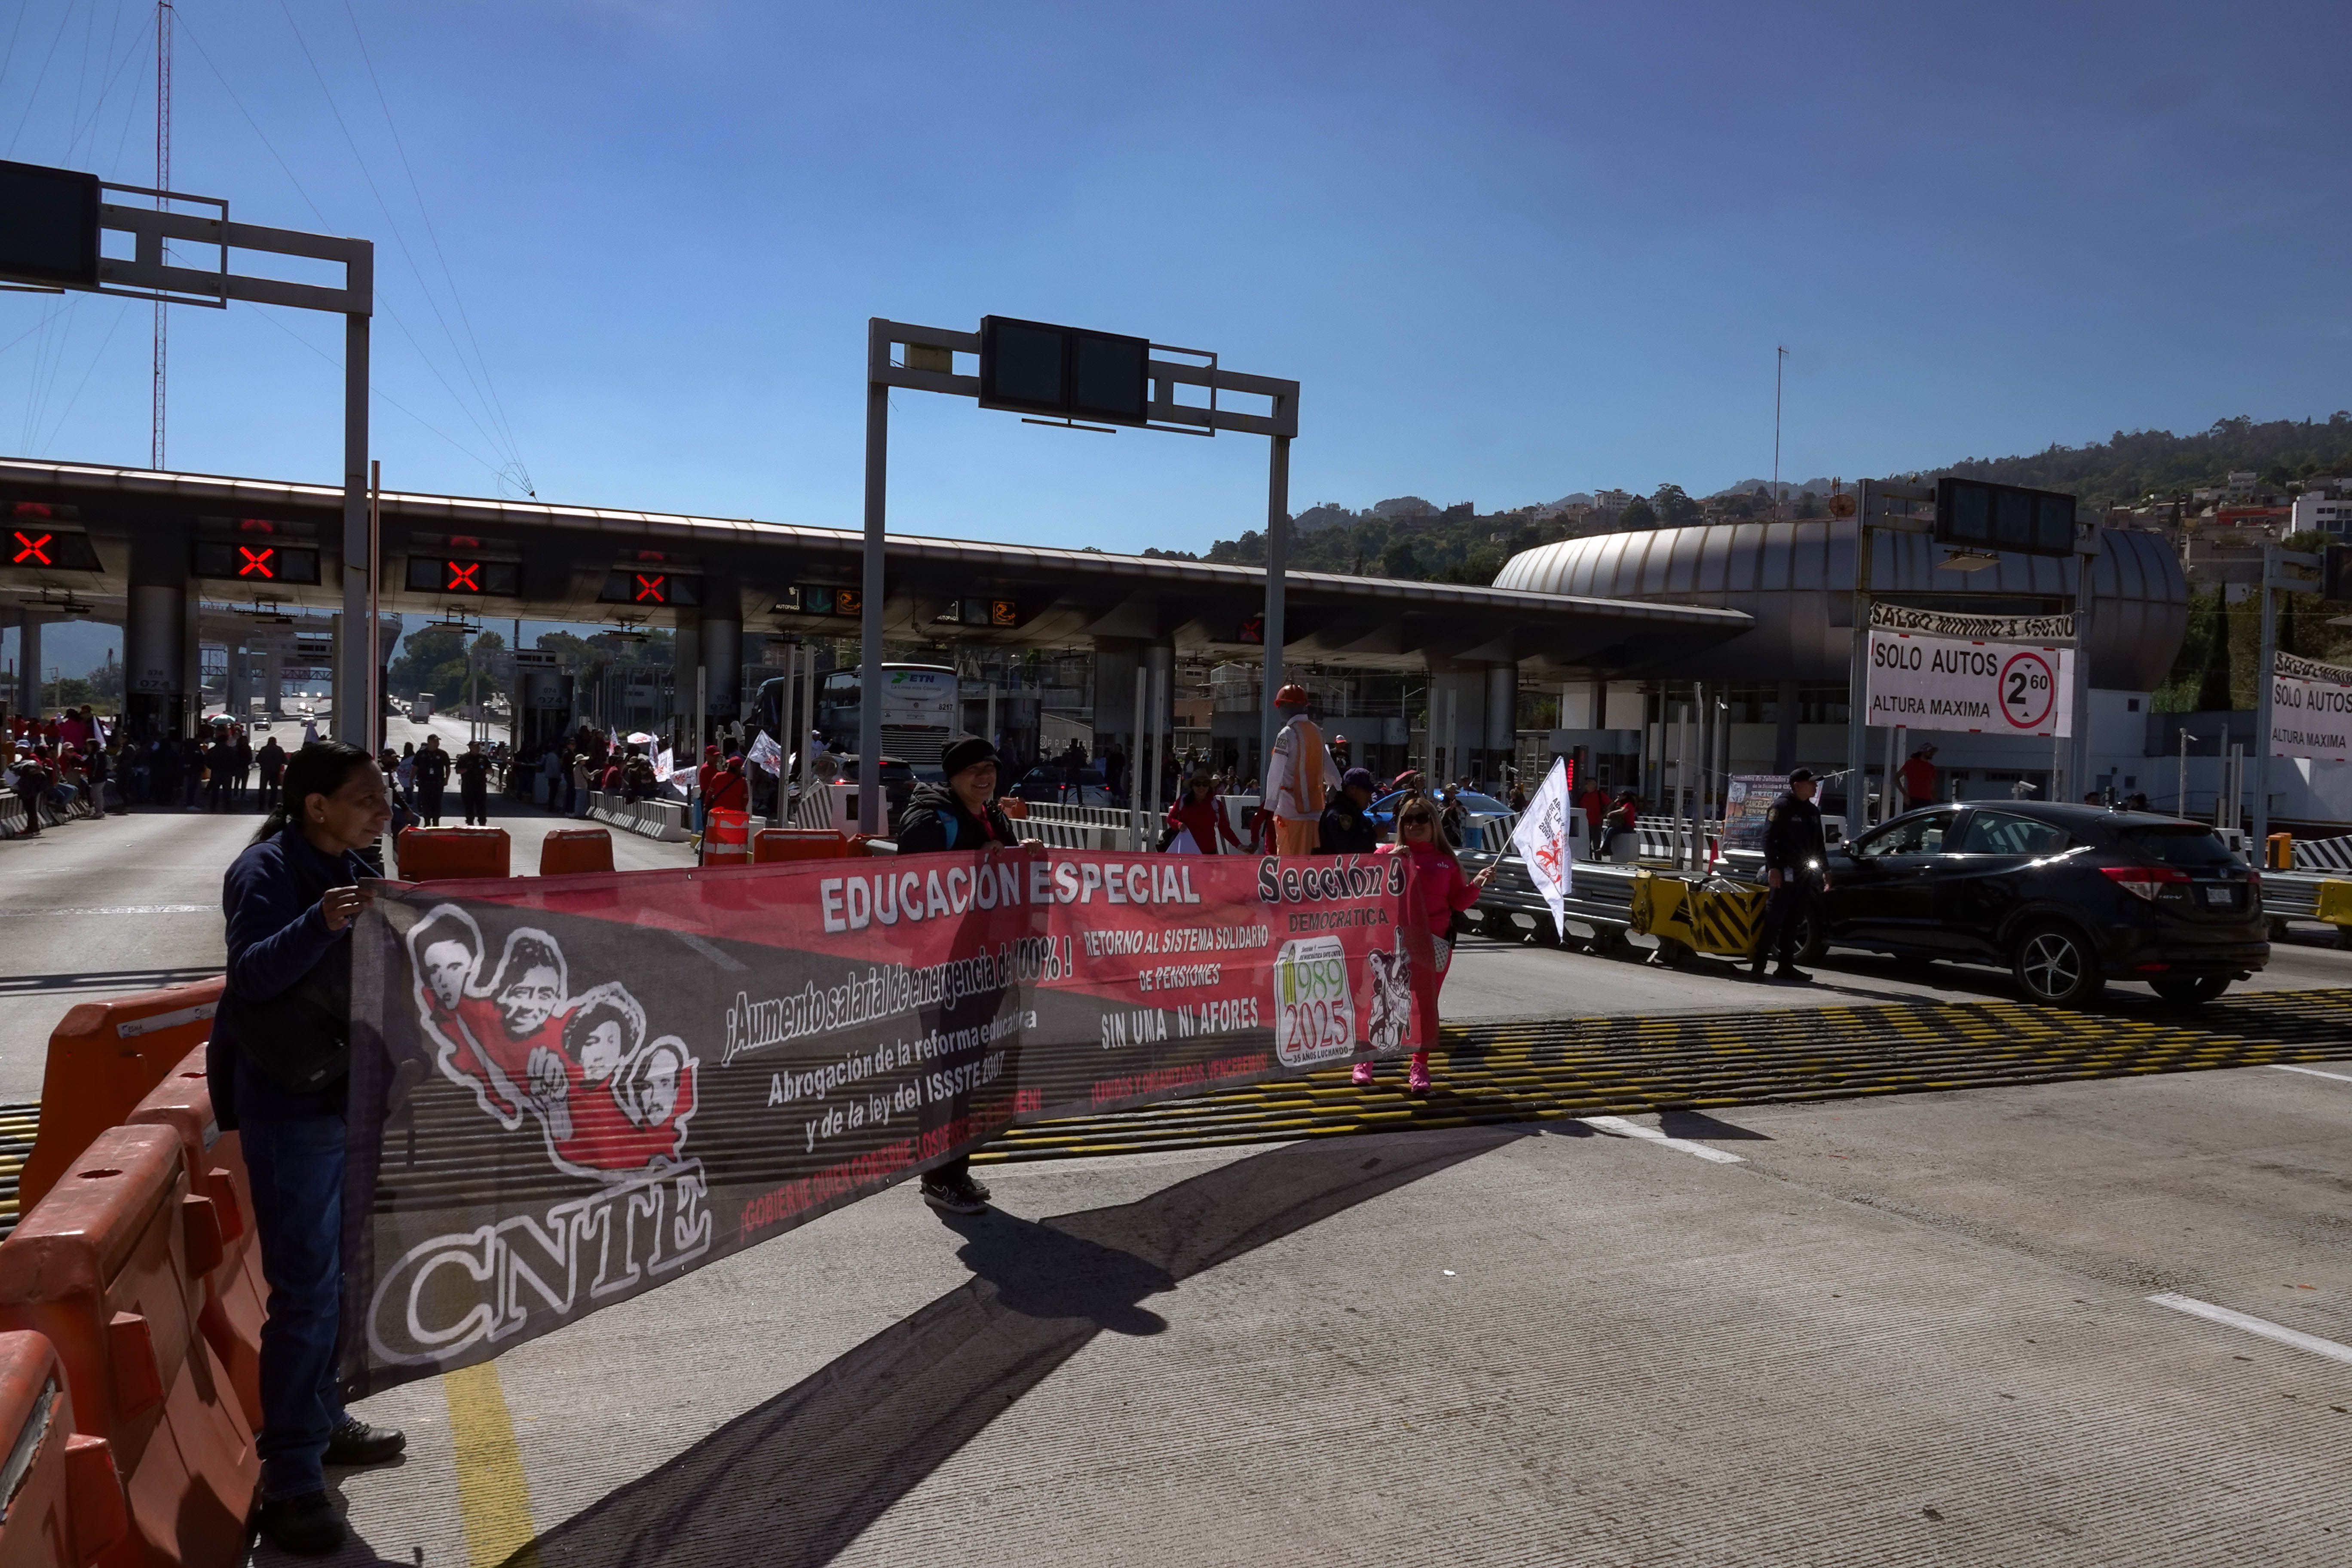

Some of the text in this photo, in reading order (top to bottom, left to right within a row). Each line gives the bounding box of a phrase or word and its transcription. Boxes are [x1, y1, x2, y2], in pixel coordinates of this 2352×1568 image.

[1872, 604, 1933, 630] SALDO
[1874, 642, 1998, 677] SOLO AUTOS
[910, 674, 935, 683] ETN
[1872, 695, 1991, 719] ALTURA MAXIMA
[2274, 683, 2352, 714] SOLO AUTOS
[2272, 727, 2346, 748] ALTURA MAXIMA
[1538, 822, 1551, 839] 2007
[821, 853, 1201, 933] EDUCACIÓN ESPECIAL
[1257, 854, 1407, 903] Sección 9
[1289, 906, 1390, 933] DEMOCRÁTICA
[1083, 924, 1269, 957] RETORNO AL SISTEMA SOLIDARIO
[1139, 963, 1222, 992] DE PENSIONES
[720, 979, 825, 1069] ¡Aumento
[825, 964, 891, 1031] salarial
[890, 962, 910, 1013] de
[910, 945, 997, 1011] emergencia
[1101, 996, 1259, 1050] SIN UMA NI AFORES
[1285, 997, 1348, 1053] 2025
[767, 1050, 873, 1108] Abrogación
[875, 1044, 894, 1074] de
[897, 1038, 911, 1068] la
[914, 1025, 979, 1062] reforma
[1292, 1045, 1349, 1063] 35 AÑOS LUCHANDO
[805, 1050, 1006, 1155] y de la ley del ISSSTE 2007
[813, 1160, 852, 1204] QUIEN
[366, 1156, 712, 1366] CNTE
